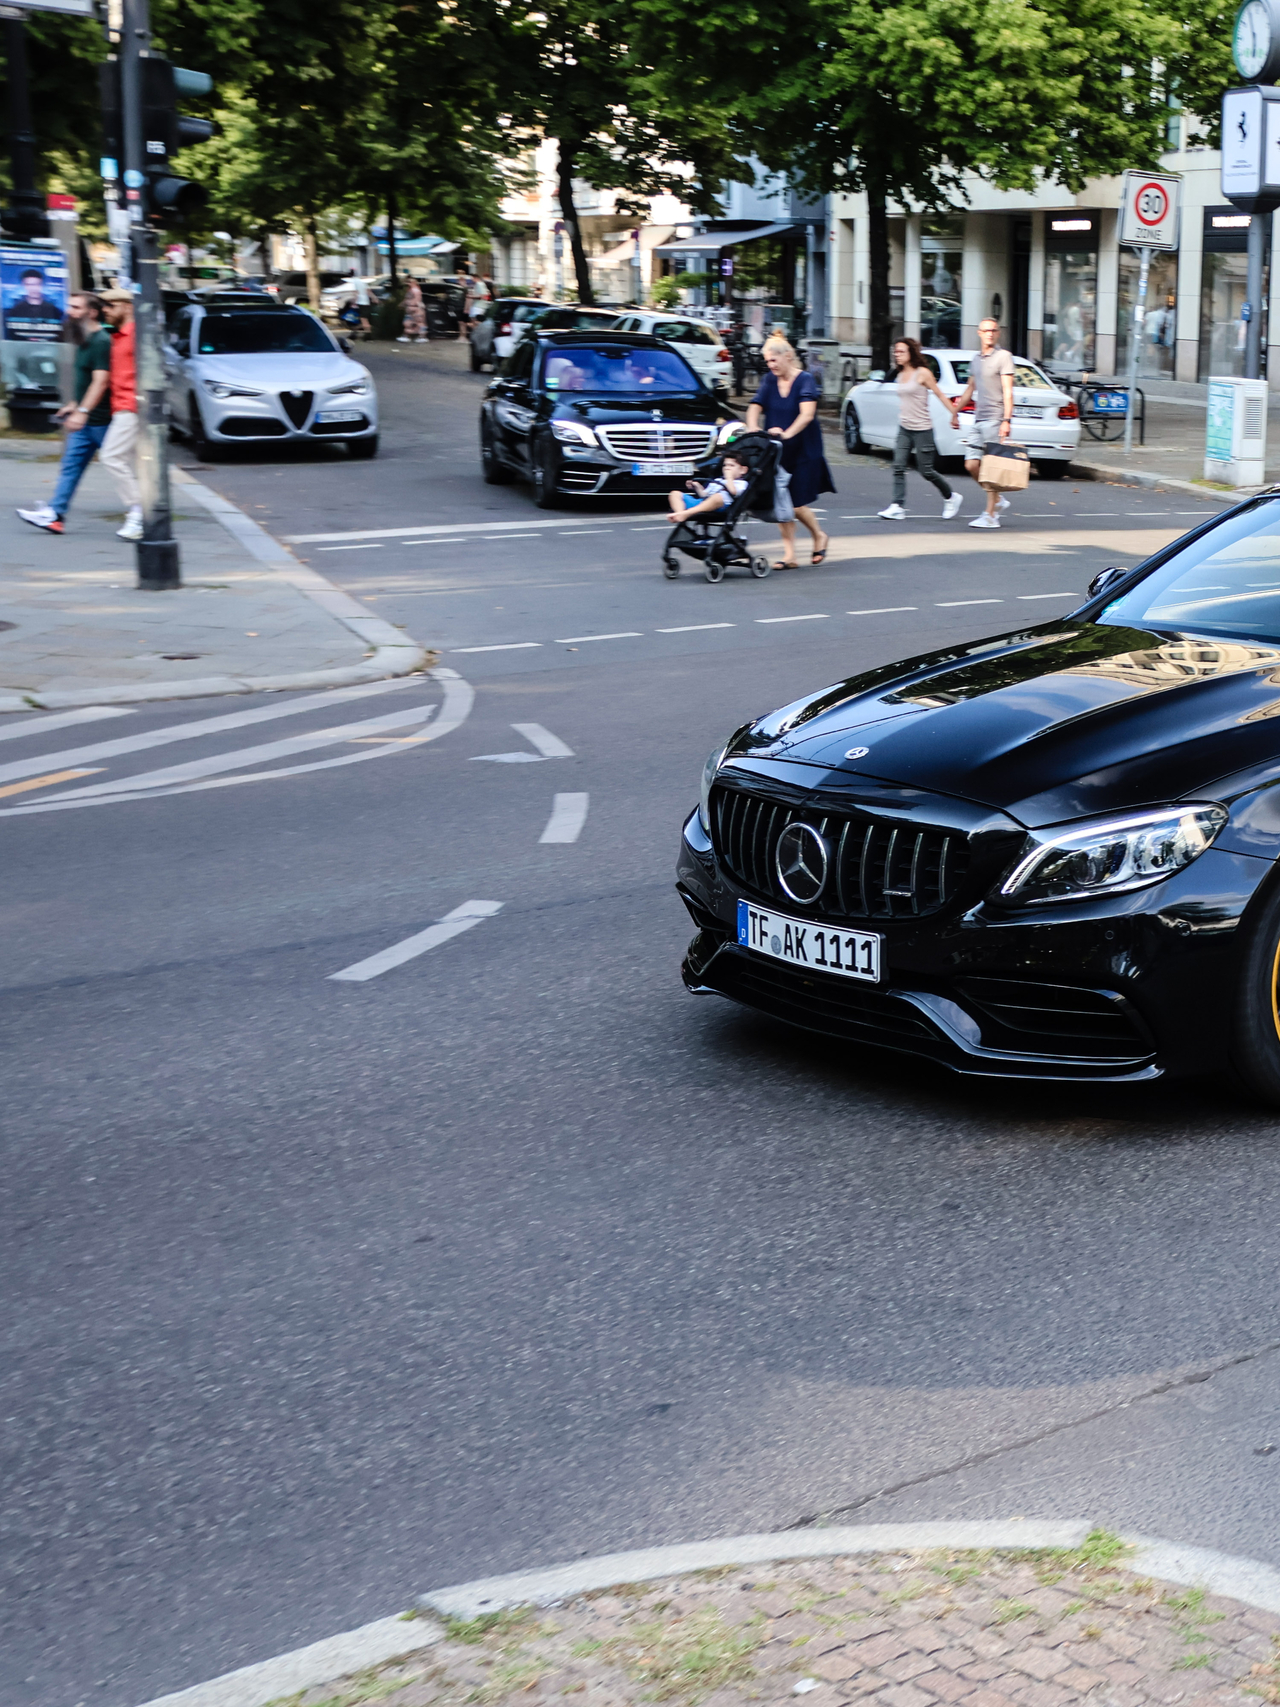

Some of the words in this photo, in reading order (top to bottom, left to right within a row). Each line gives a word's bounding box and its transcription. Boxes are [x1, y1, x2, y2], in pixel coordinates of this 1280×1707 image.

[1141, 193, 1162, 214] 30
[1135, 227, 1163, 241] ZONE
[741, 928, 746, 938] D
[749, 910, 769, 947] TF
[784, 923, 808, 962] AK
[814, 931, 875, 975] 1111
